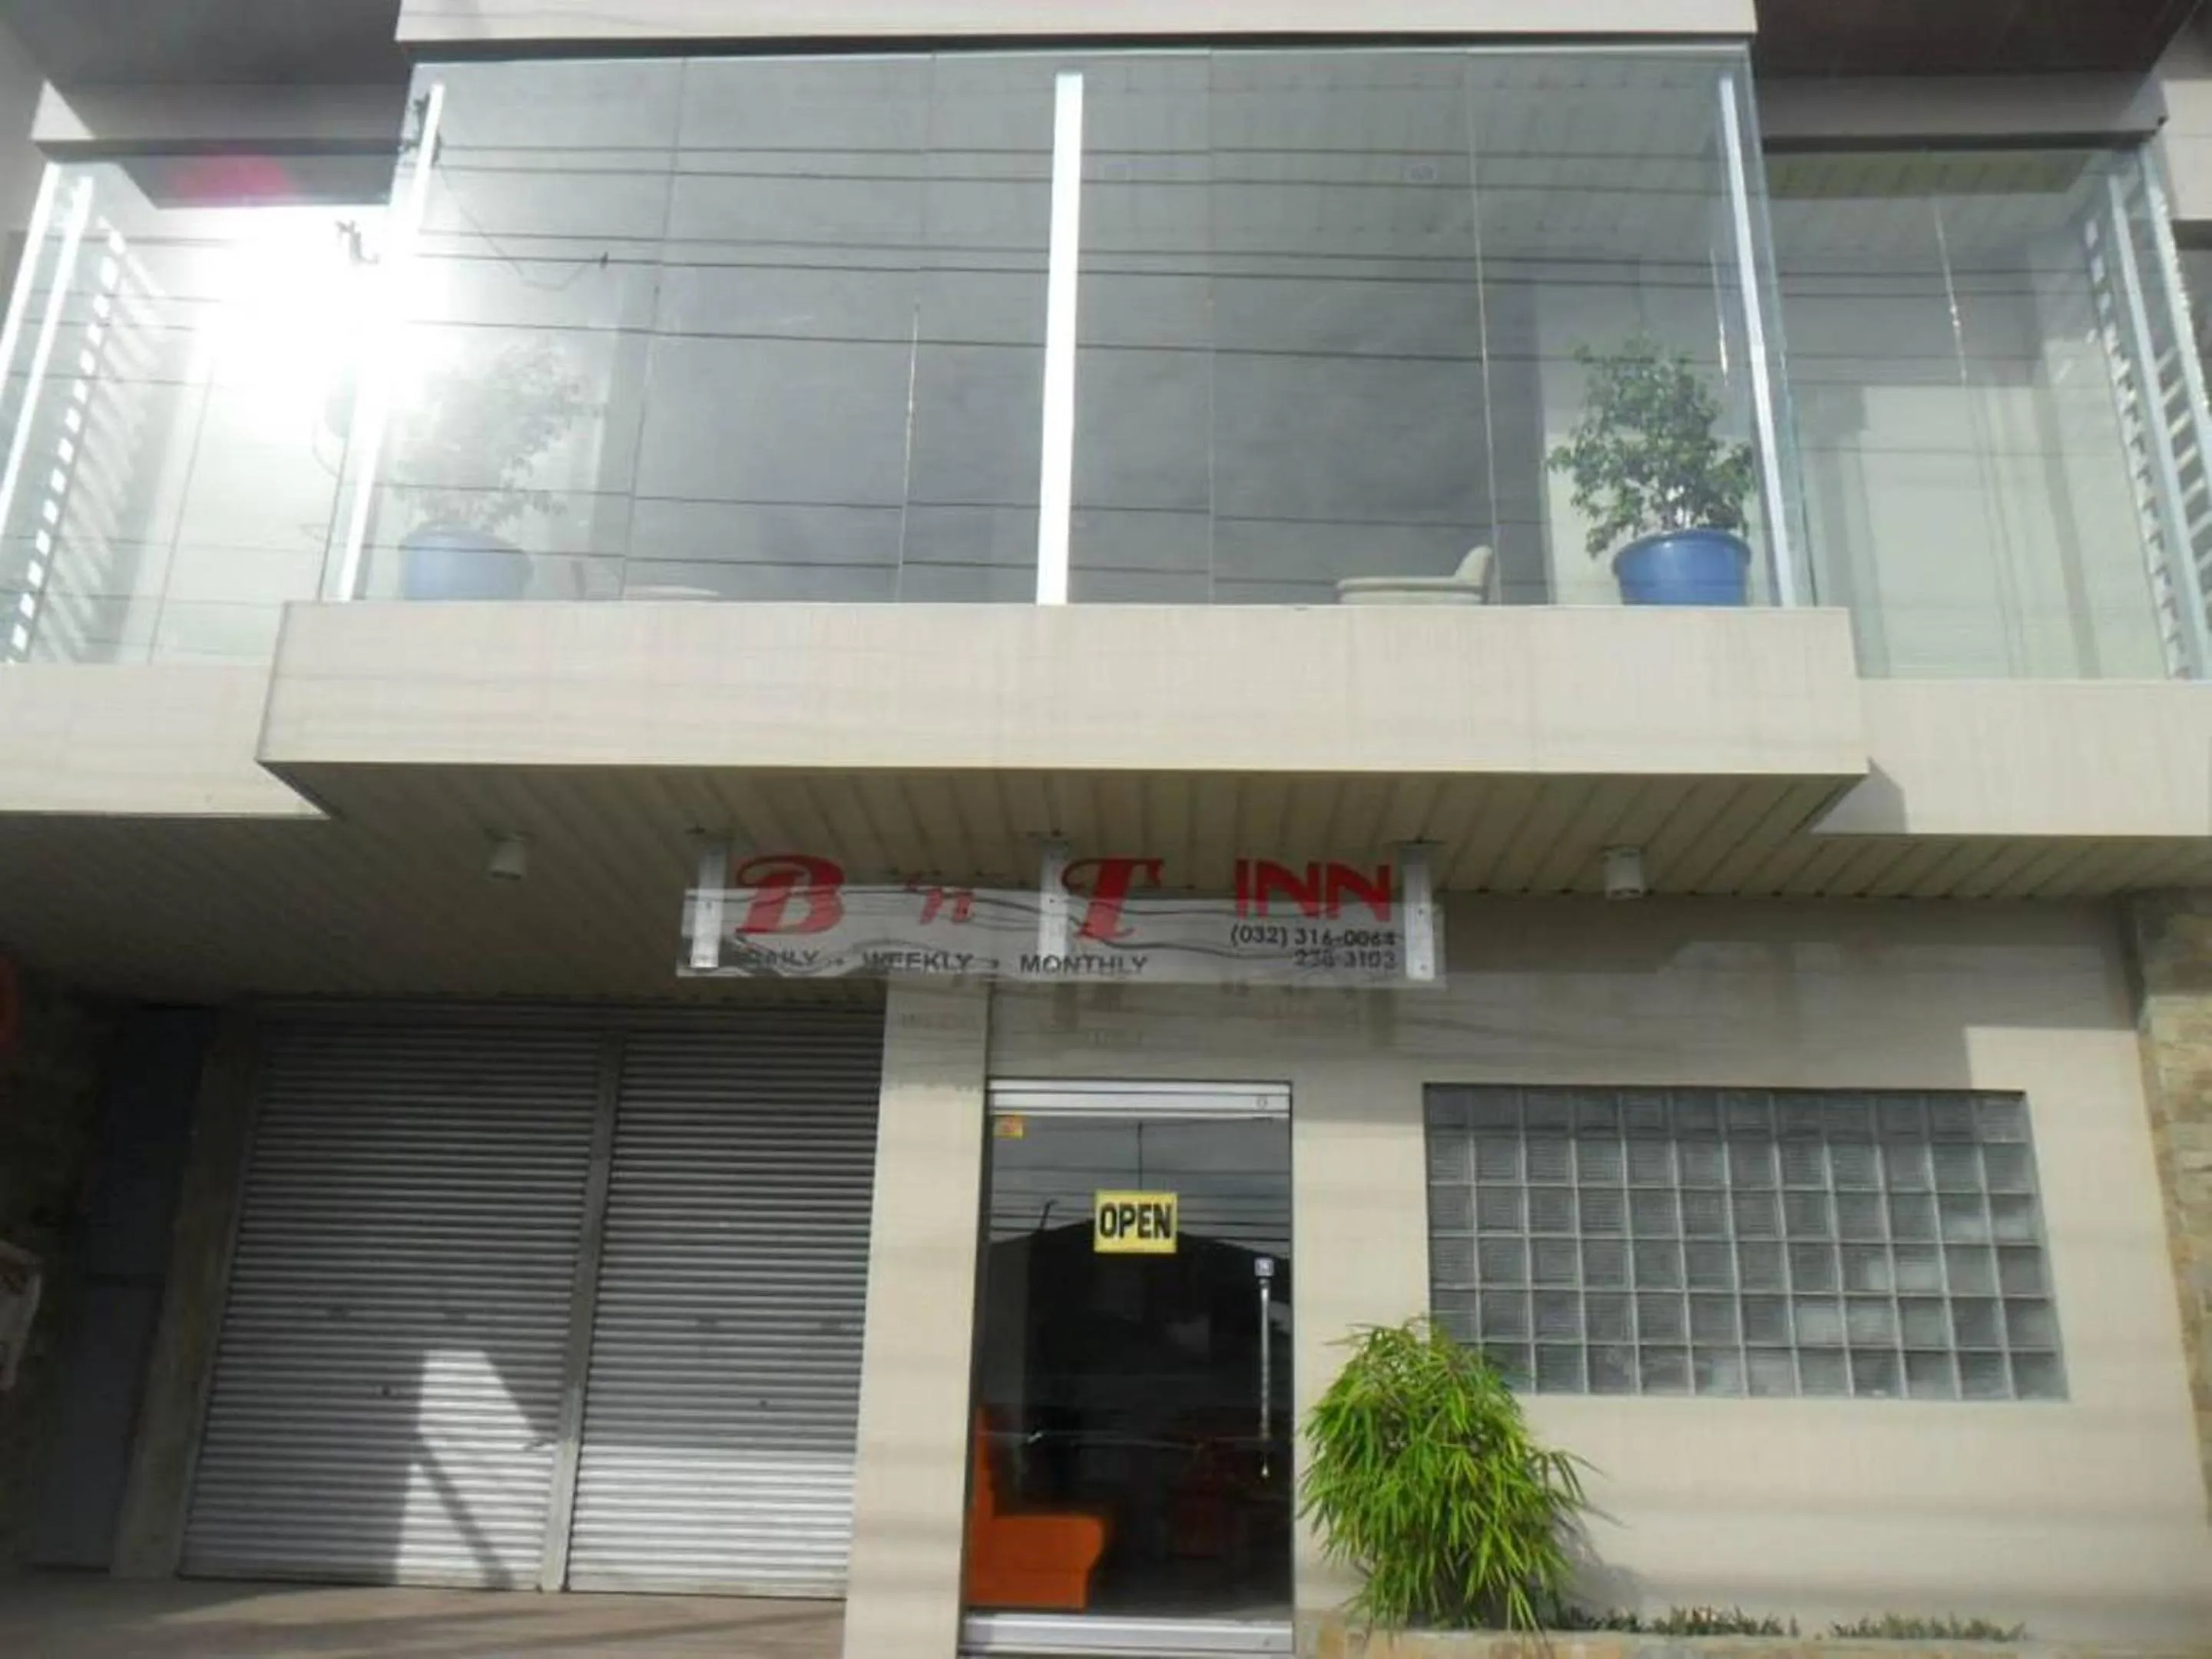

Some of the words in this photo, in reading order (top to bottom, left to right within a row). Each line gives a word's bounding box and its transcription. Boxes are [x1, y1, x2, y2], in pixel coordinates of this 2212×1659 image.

[735, 854, 843, 935] B
[1235, 859, 1392, 921] INN
[1230, 924, 1288, 948] (032)
[863, 950, 974, 971] WEEKLY
[1020, 954, 1148, 975] MONTHLY
[1100, 1203, 1172, 1239] OPEN
